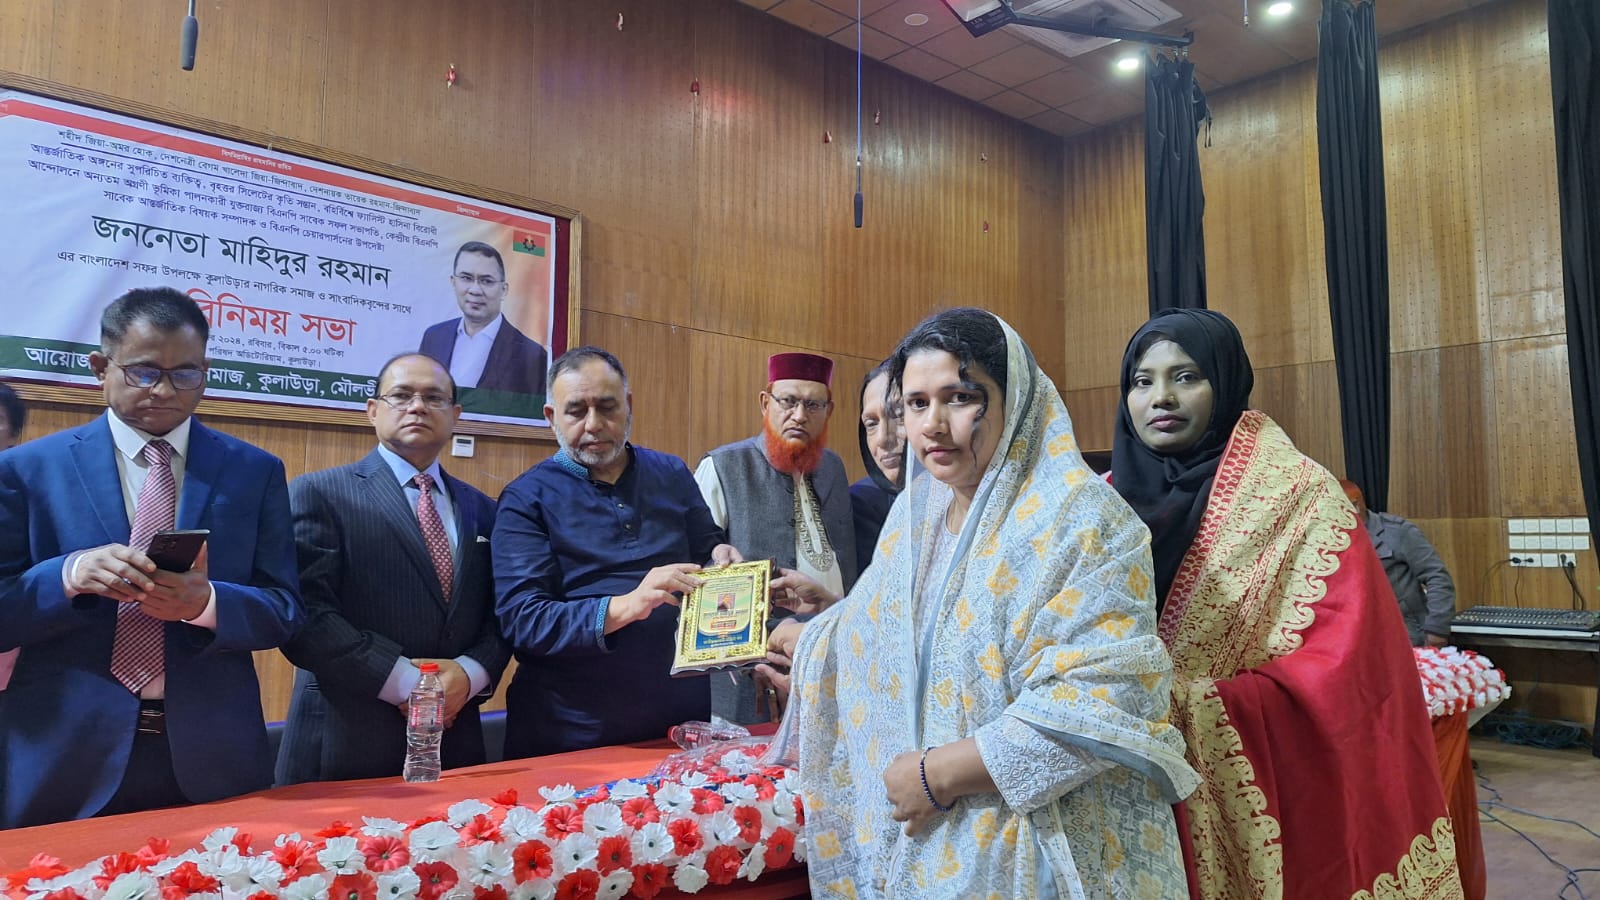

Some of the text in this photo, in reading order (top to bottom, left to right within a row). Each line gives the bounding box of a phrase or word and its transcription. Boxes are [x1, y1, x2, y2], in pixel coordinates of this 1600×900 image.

[31, 143, 85, 162] আন্তর্জাতিক
[88, 155, 124, 171] অঙ্গনের
[126, 164, 168, 179] সুপরিচিত
[210, 181, 235, 193] বৃহত্তর
[239, 185, 273, 201] সিলেটের
[276, 193, 294, 206] কৃতি
[388, 218, 411, 232] হাসিনা
[413, 221, 438, 236] বিরোধী
[58, 129, 81, 142] শহীদ
[198, 160, 219, 172] বেগম
[222, 164, 249, 179] খালেদা
[310, 184, 342, 198] দেশনায়ক
[345, 192, 367, 203] তারেক
[28, 159, 80, 177] আন্দোলনে
[83, 170, 120, 185] অন্যতম
[184, 191, 226, 206] পালনকারী
[267, 205, 297, 220] বিএনপি
[299, 214, 325, 225] সাবেক
[328, 220, 347, 231] সফল
[412, 235, 439, 249] বিএনপি
[103, 190, 385, 252] সাবেক আন্তর্জাতিক বিষয়ক সম্পাদক ও বিএনপি চেয়ারপার্সনের উপদেষ্টা
[57, 250, 412, 314] এর বাংলাদেশ সফর উপলক্ষে কুলাউড়ার নাগরিক সমাজ ও সাংবাদিকবৃন্দের সাথে
[91, 215, 392, 289] জননেতা মাহিদুর রহমান
[186, 288, 358, 346] বিনিময় সভা
[278, 340, 300, 352] বিকাল
[24, 347, 91, 370] আয়োজ
[206, 366, 251, 389] মাজ,
